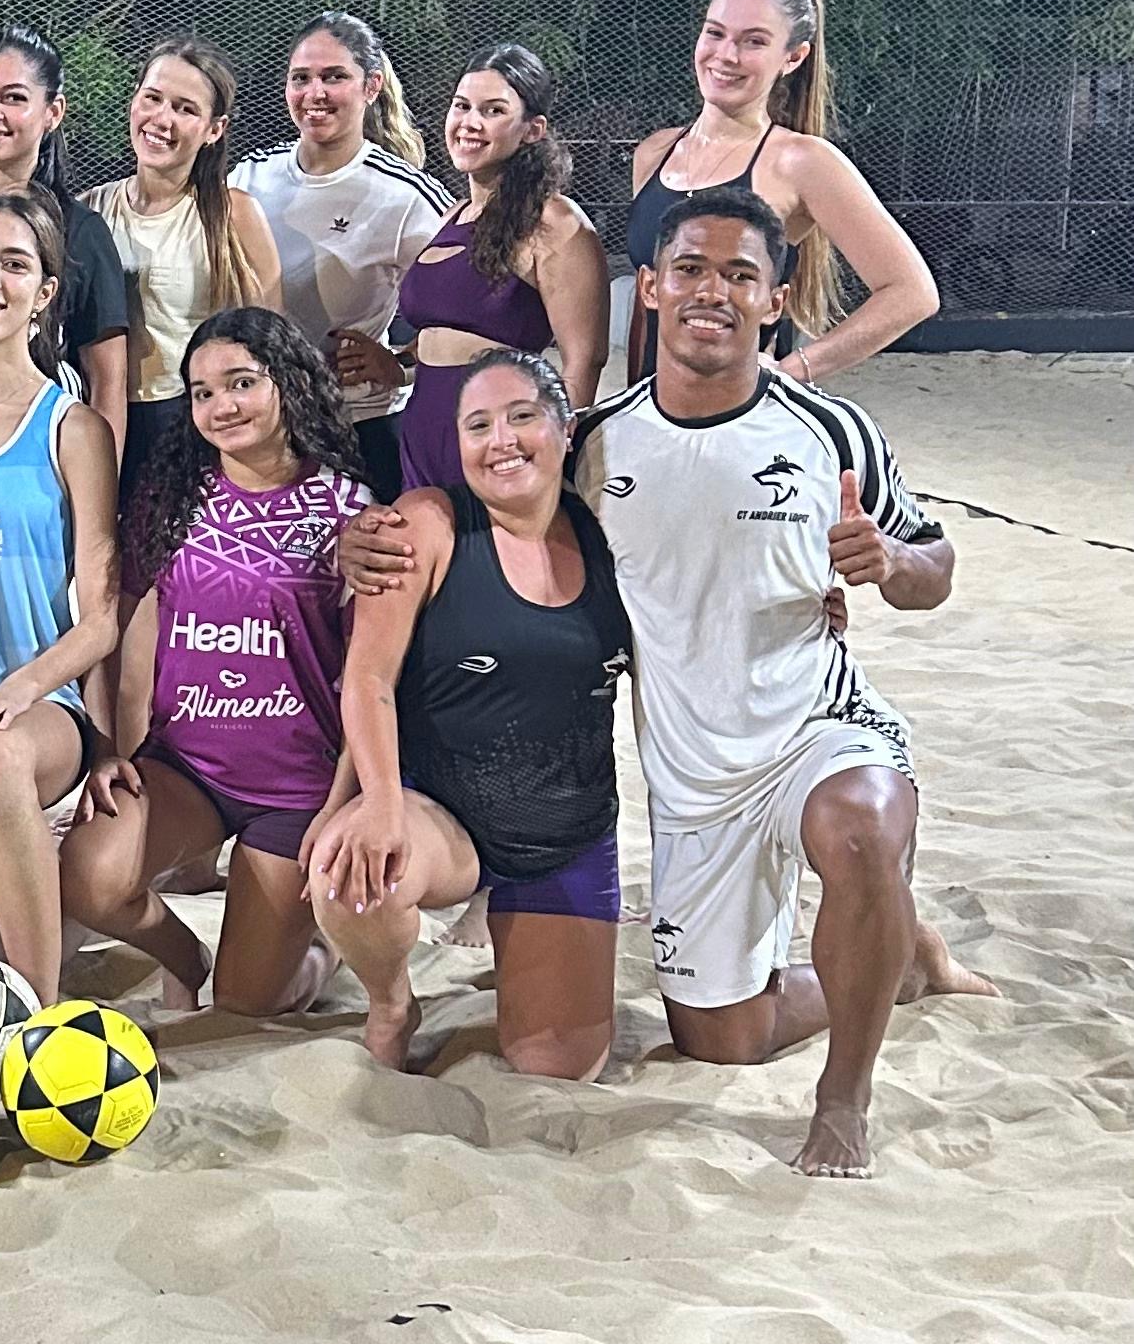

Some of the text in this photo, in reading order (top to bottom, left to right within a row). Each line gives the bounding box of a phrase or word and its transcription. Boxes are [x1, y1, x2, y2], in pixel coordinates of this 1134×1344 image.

[736, 510, 749, 520] CT
[749, 510, 787, 522] ANDRIER
[169, 610, 286, 659] Health
[171, 682, 305, 723] Alimente
